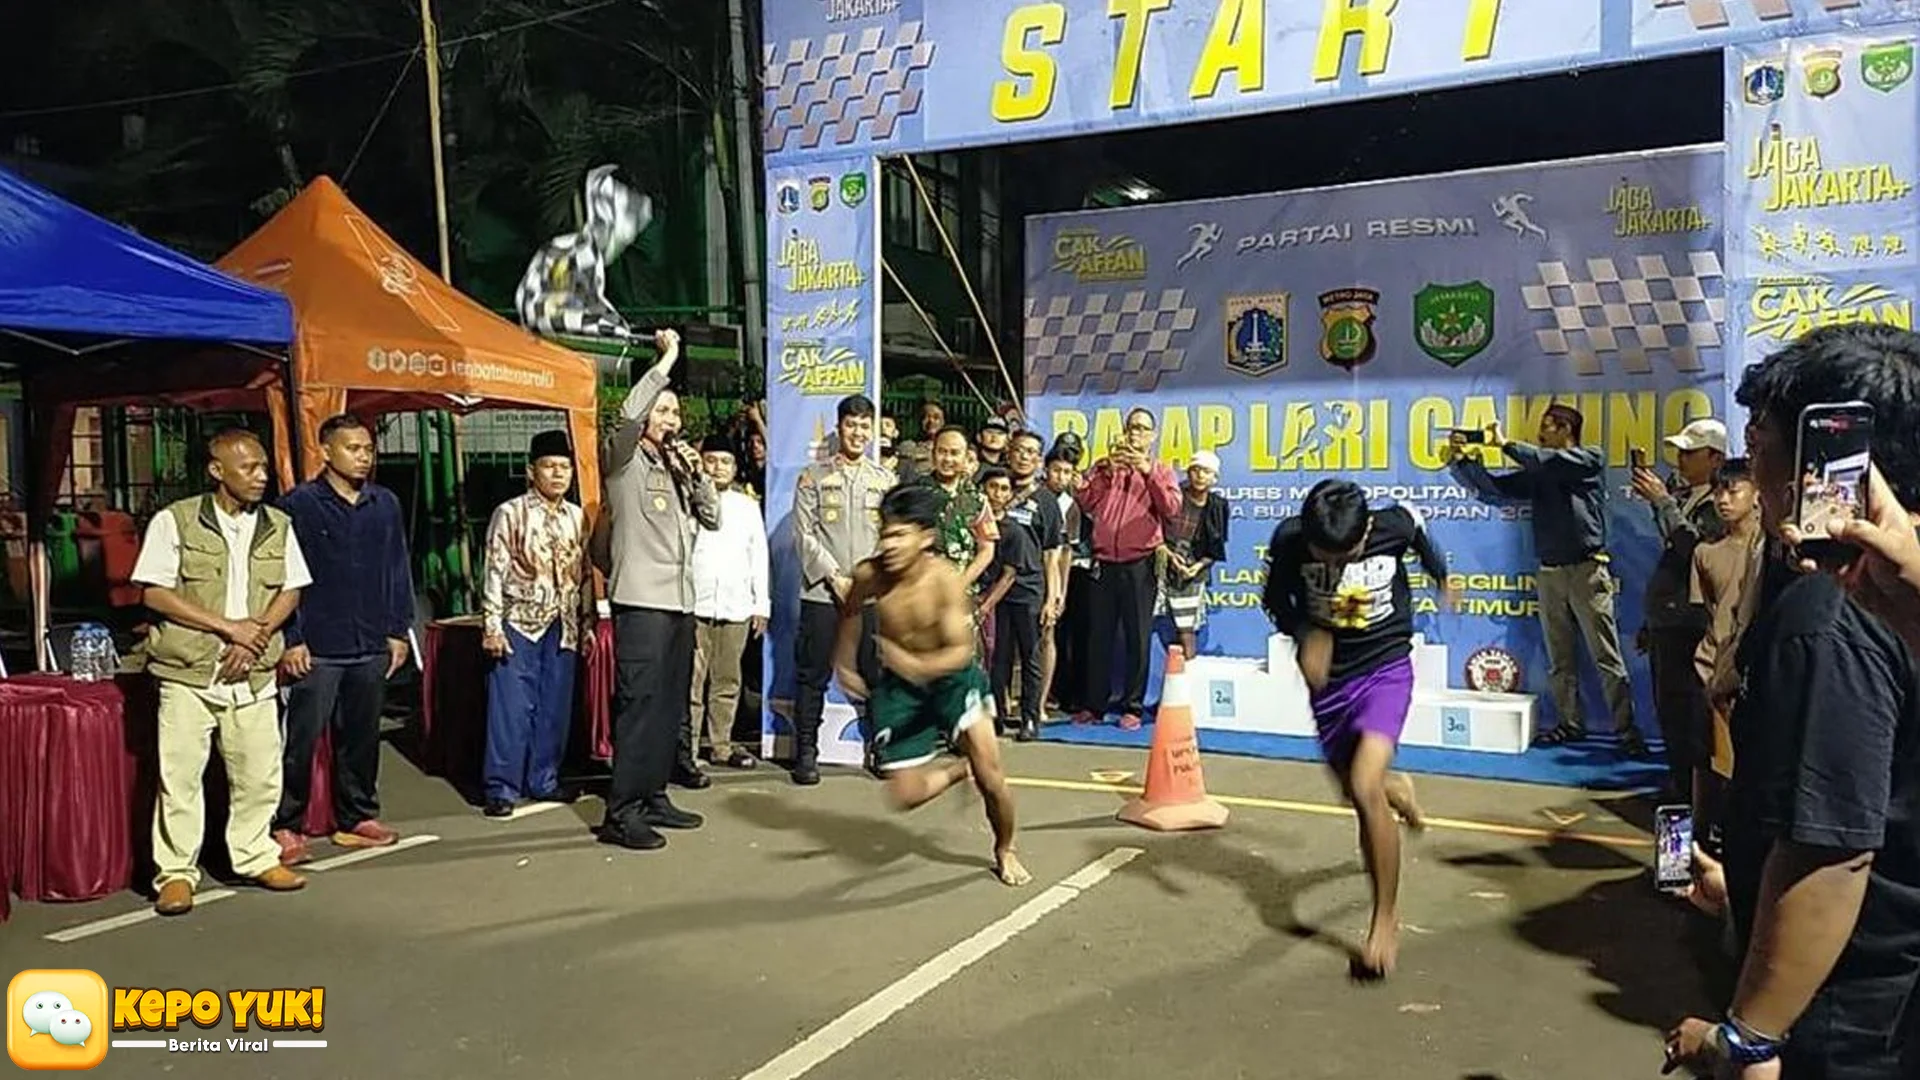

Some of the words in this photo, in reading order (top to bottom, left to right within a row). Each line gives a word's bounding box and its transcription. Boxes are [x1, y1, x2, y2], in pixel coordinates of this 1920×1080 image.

[1746, 136, 1821, 178] JAGA
[1604, 185, 1653, 213] JAGA
[1055, 236, 1100, 260] CAK
[1238, 222, 1352, 254] PARTAI
[1367, 217, 1477, 237] RESMI
[777, 239, 820, 267] JAGA
[1079, 244, 1145, 273] AFFAN
[1752, 286, 1833, 321] CAK
[781, 348, 824, 371] CAK
[803, 361, 866, 387] AFFAN
[1249, 399, 1390, 472] LARI
